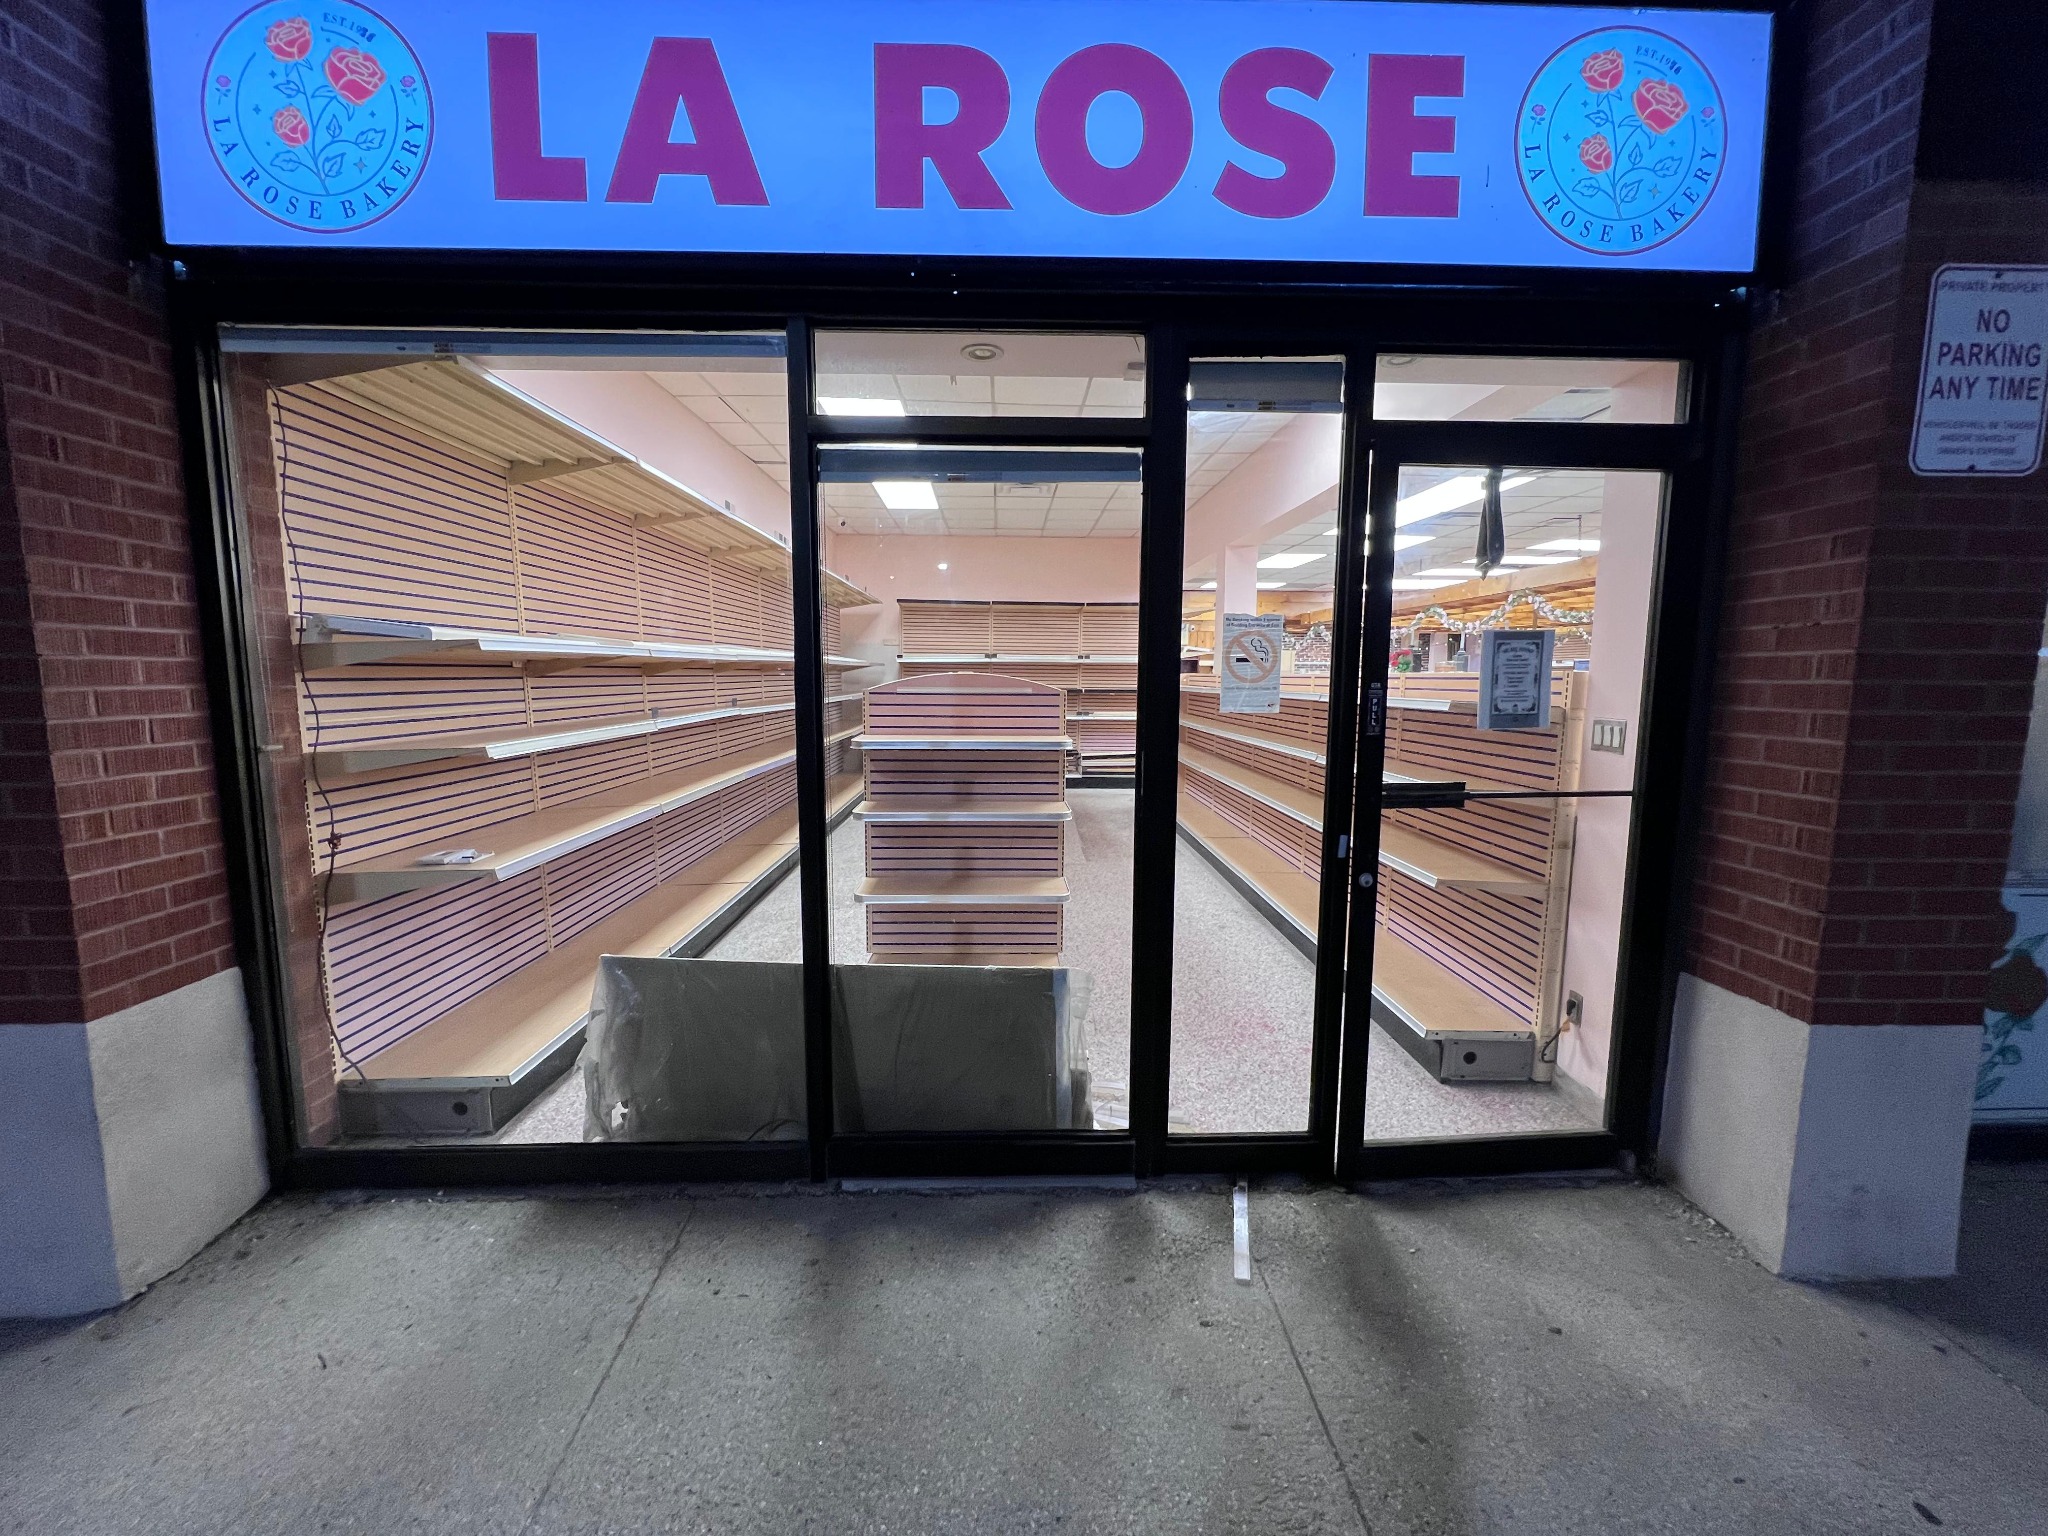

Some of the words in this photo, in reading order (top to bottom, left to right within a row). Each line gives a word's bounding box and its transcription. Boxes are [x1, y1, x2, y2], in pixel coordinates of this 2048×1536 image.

[487, 32, 770, 206] LA
[874, 43, 1465, 219] ROSE
[213, 116, 239, 157] LA
[240, 166, 322, 220] ROSE
[340, 117, 424, 220] BAKERY
[1524, 144, 1546, 183] LA
[1542, 192, 1614, 243] ROSE
[1629, 146, 1717, 243] BAKERY
[1976, 309, 2011, 333] NO
[1937, 342, 2041, 368] PARKING
[1929, 376, 1980, 401] ANY
[1986, 376, 2042, 401] TIME
